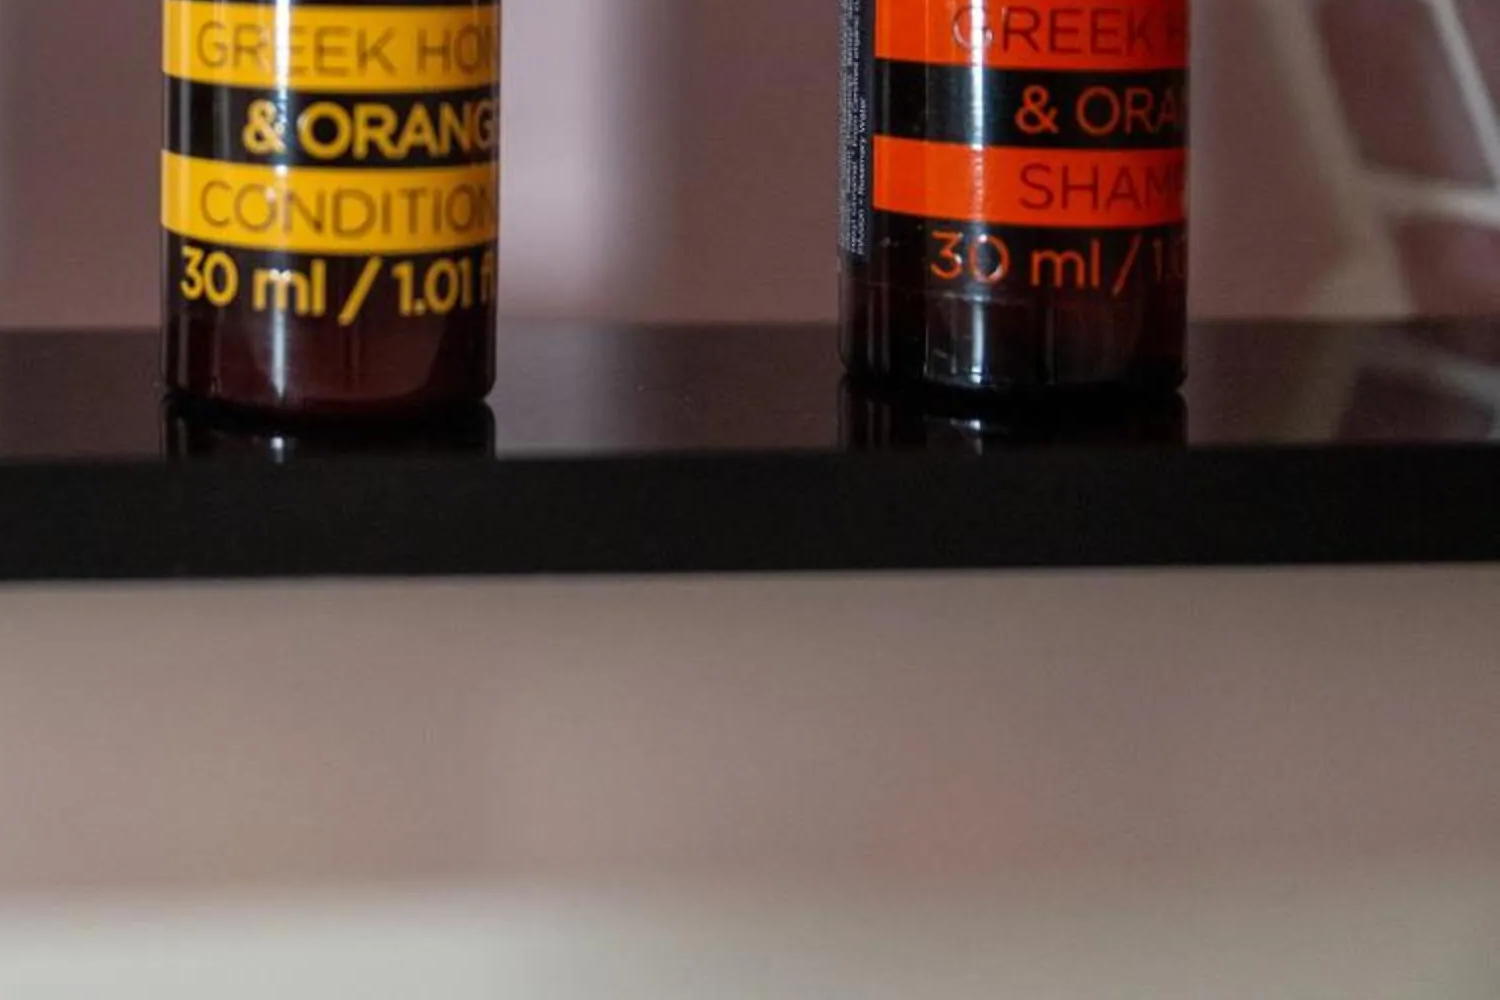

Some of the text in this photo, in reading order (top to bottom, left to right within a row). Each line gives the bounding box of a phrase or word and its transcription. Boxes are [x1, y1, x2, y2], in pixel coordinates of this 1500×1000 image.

[197, 19, 397, 77] GREEK
[953, 5, 1152, 56] GREEK
[243, 100, 287, 155] &
[1015, 85, 1059, 135] &
[181, 245, 239, 306] 30
[252, 257, 328, 317] ml
[392, 256, 472, 317] 1.01
[931, 231, 1010, 284] 30
[1030, 238, 1102, 287] ml
